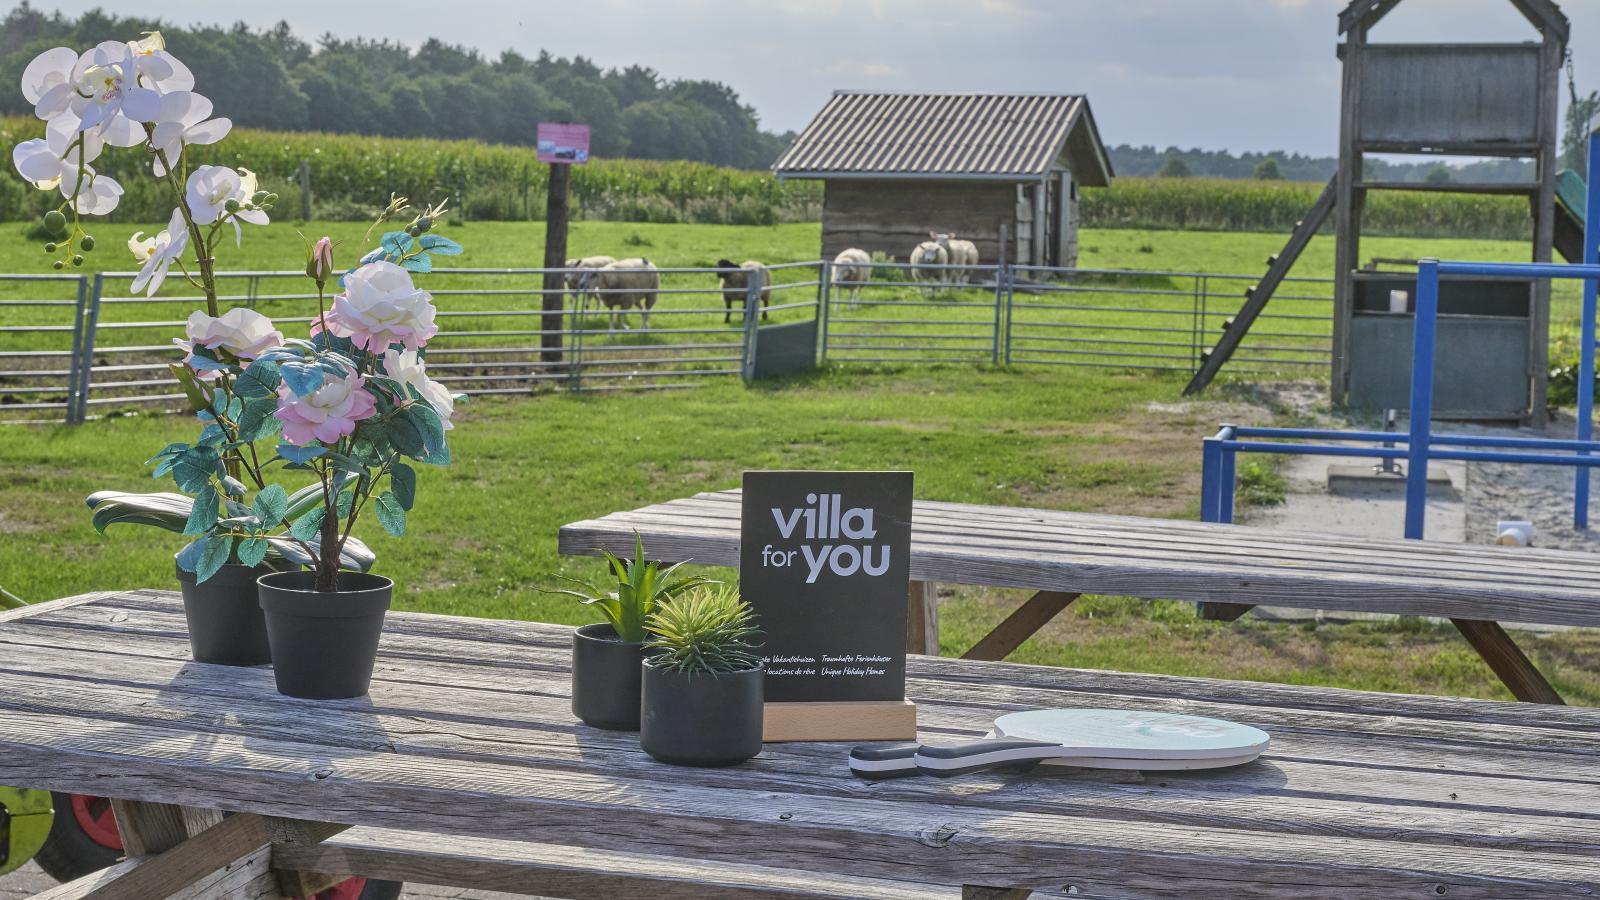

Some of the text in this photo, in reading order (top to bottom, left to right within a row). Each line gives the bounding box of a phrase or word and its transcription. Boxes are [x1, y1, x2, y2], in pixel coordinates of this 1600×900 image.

[771, 493, 877, 539] villa
[761, 544, 891, 584] for you
[772, 655, 815, 663] Vakantiehuizen
[821, 654, 891, 664] Traumhafte Ferienhäuser
[767, 667, 793, 676] locations
[794, 667, 803, 676] de
[803, 667, 816, 676] rêve
[821, 666, 885, 678] Unique Holiday Homes
